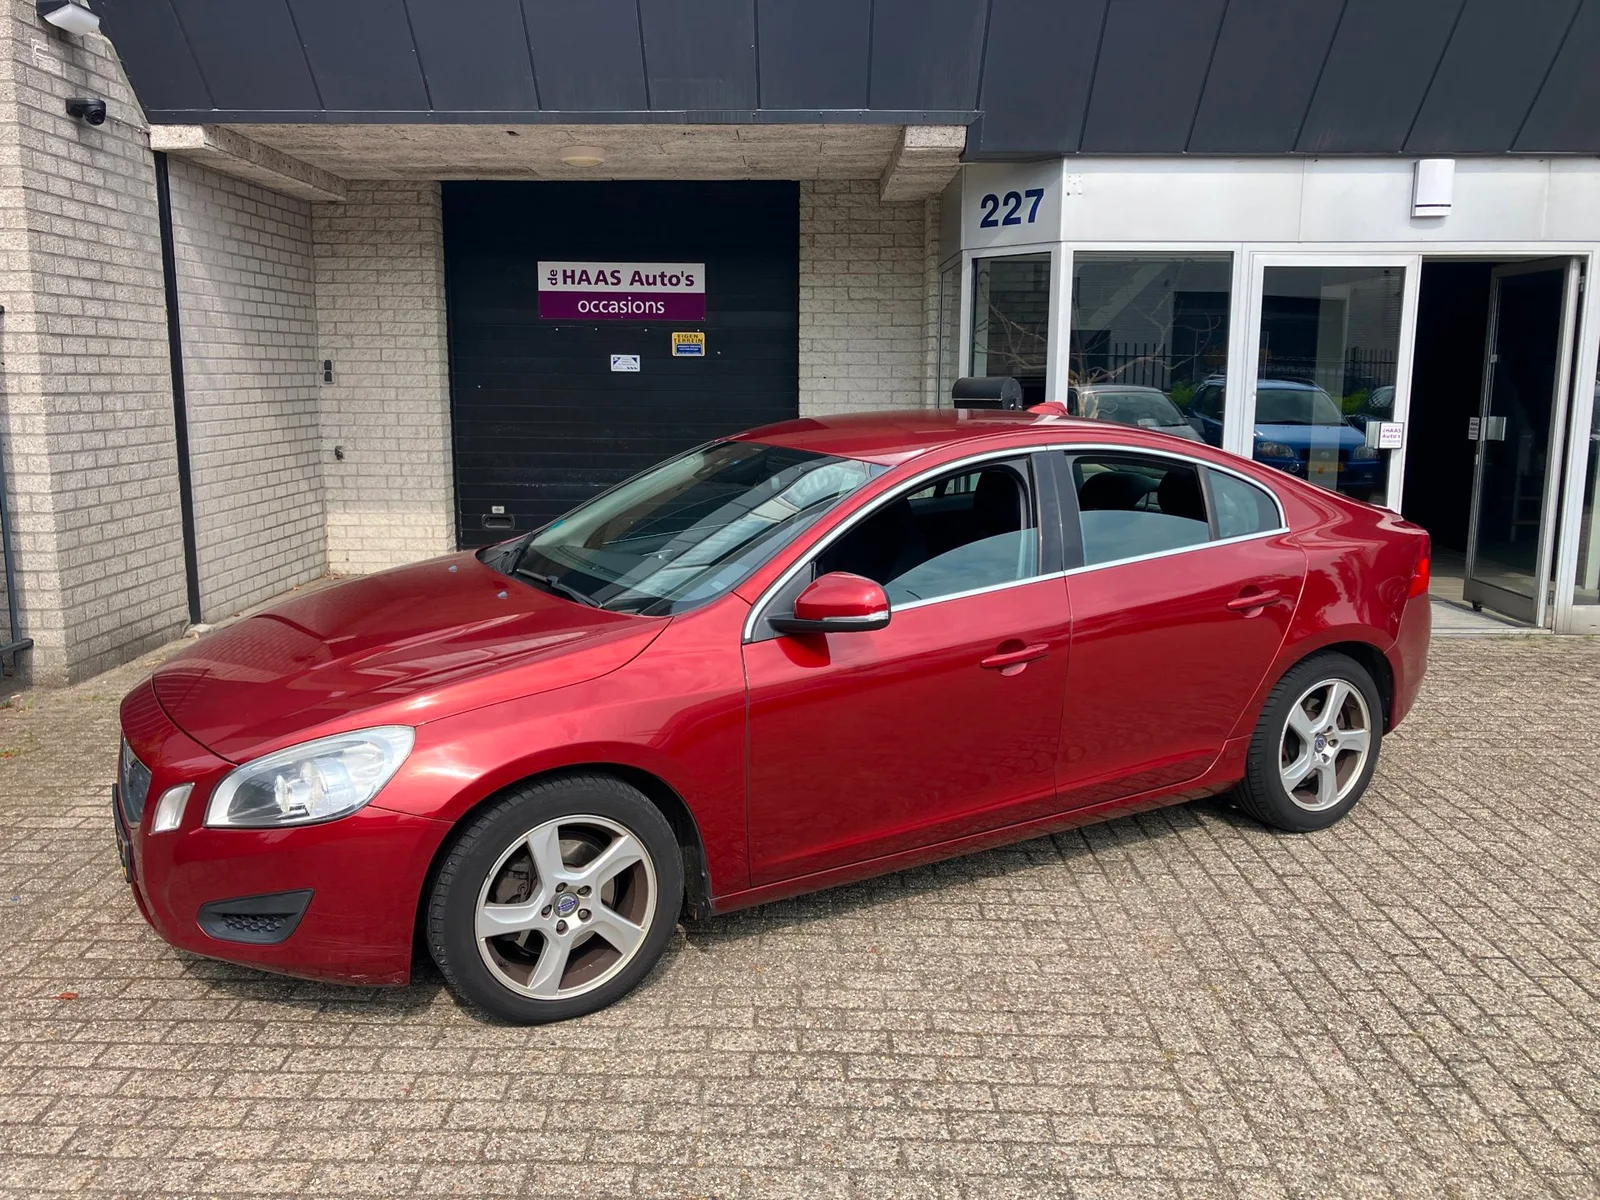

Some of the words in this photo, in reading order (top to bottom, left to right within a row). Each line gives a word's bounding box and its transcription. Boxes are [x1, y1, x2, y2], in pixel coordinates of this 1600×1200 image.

[980, 188, 1044, 228] 227
[547, 269, 558, 286] de
[562, 269, 622, 286] HAAS
[629, 270, 695, 287] Auto's
[577, 296, 665, 314] occasions
